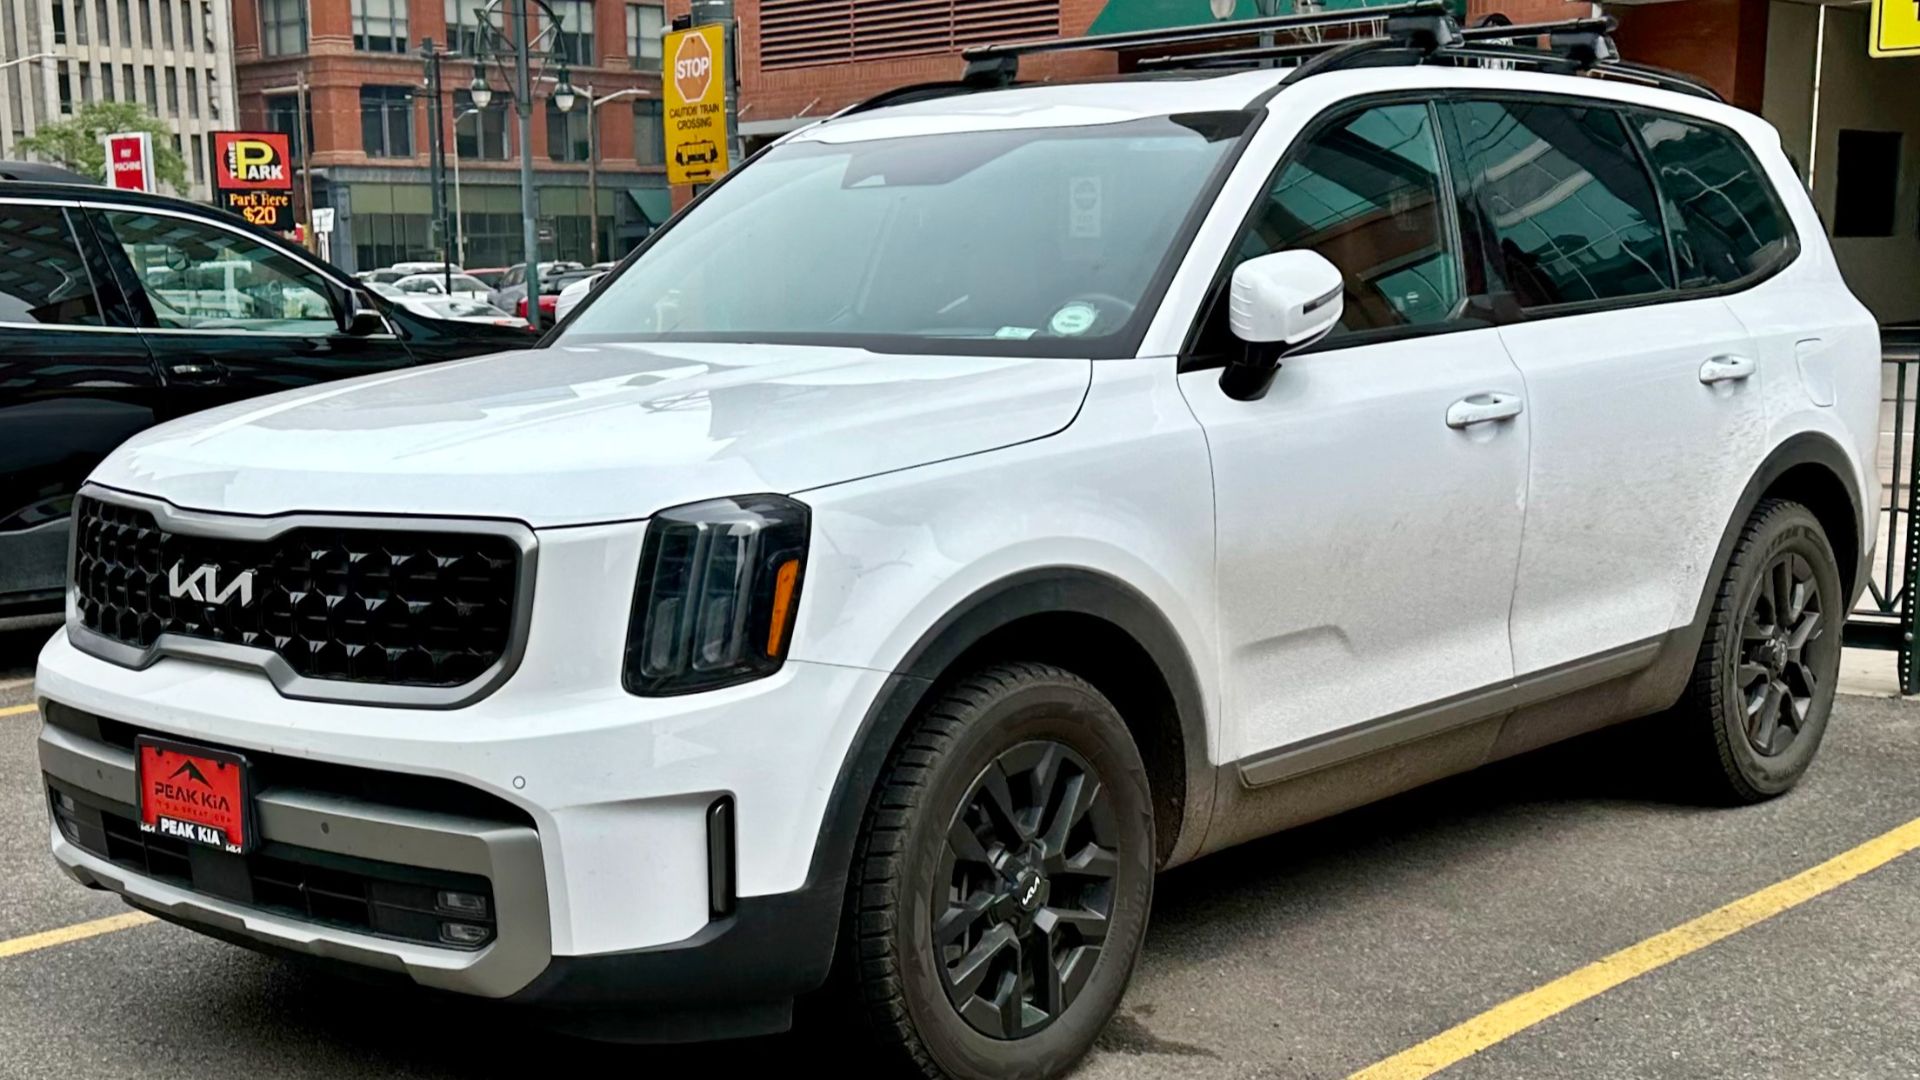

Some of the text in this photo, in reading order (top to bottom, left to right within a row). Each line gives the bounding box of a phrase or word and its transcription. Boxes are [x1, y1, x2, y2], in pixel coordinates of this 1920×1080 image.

[677, 57, 710, 80] STOP
[669, 103, 720, 118] CAUTION TRAIN
[677, 118, 712, 130] CROSSING
[114, 160, 142, 172] MACHINE
[227, 141, 239, 179] TIME
[229, 193, 289, 207] Park Here
[243, 206, 277, 225] $20
[168, 559, 257, 607] KIA
[154, 781, 199, 806] PEAK
[160, 817, 221, 846] PEAK KIA
